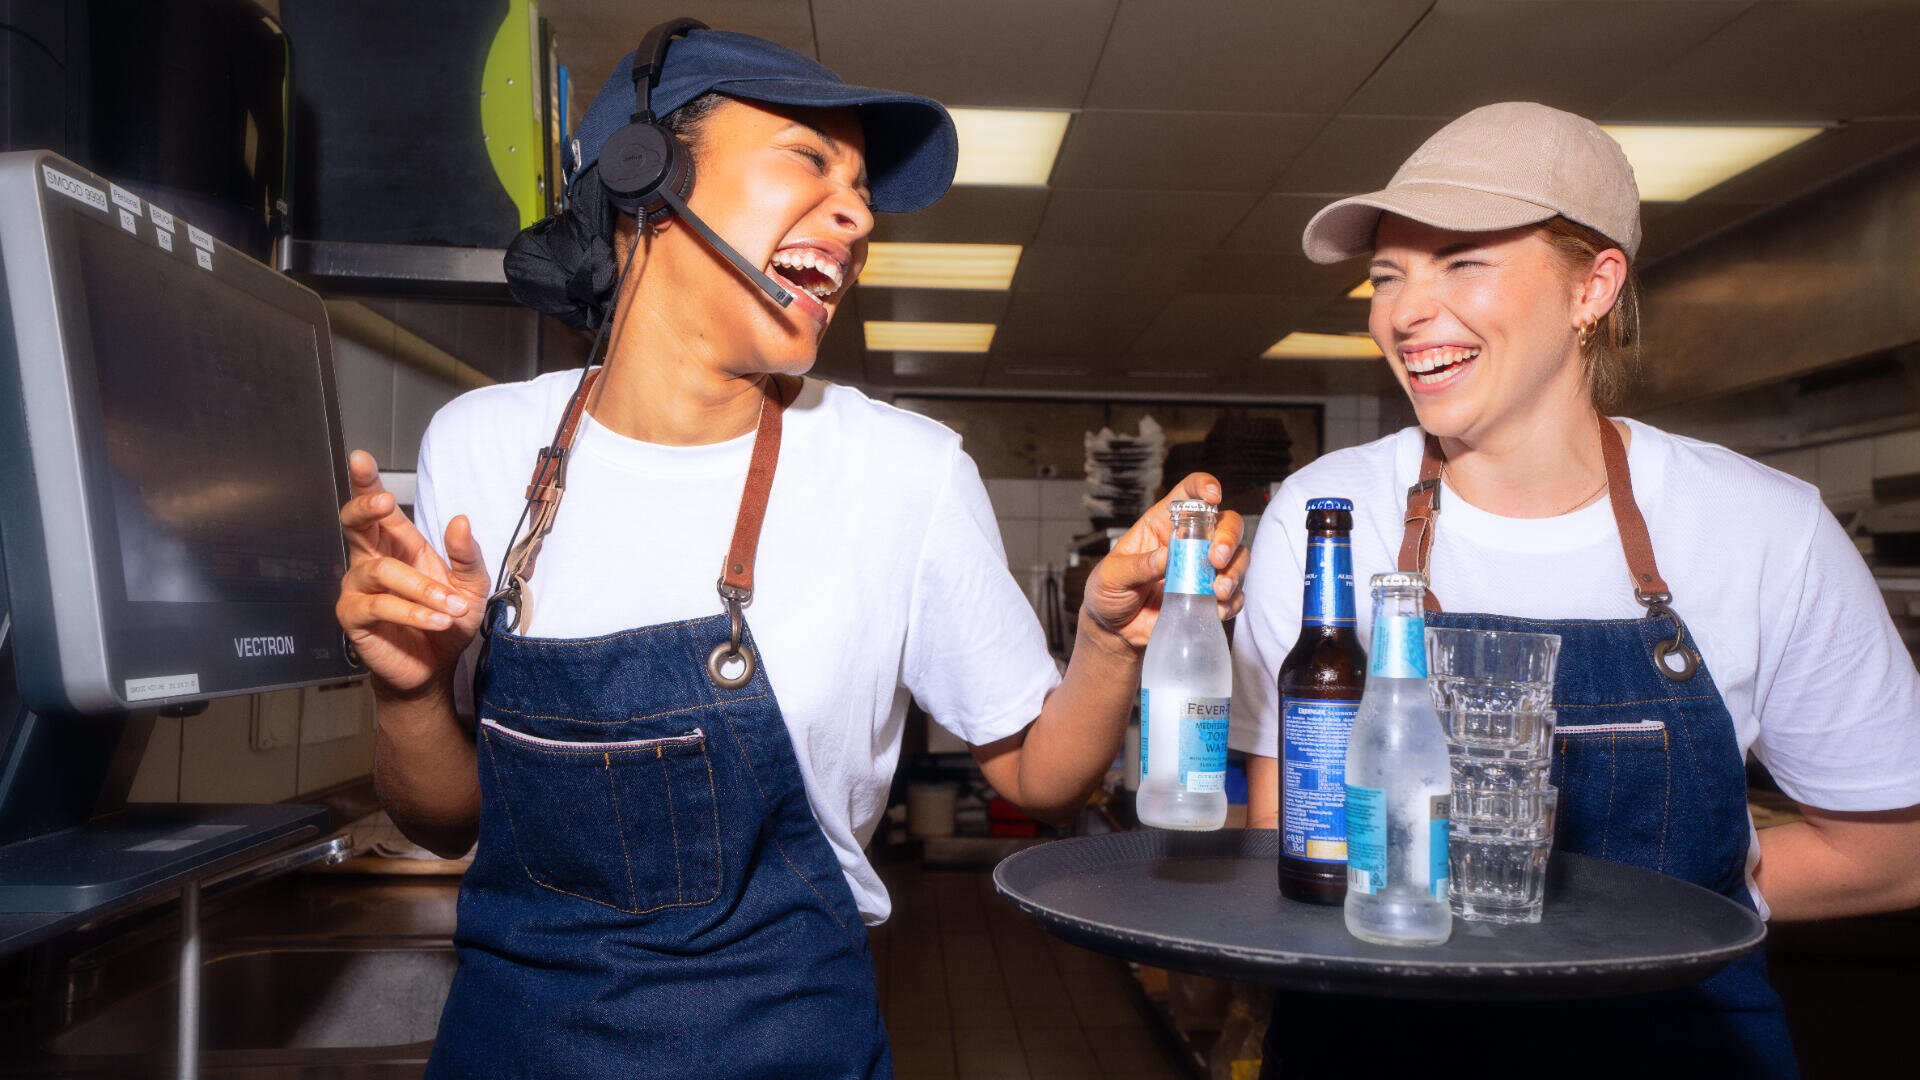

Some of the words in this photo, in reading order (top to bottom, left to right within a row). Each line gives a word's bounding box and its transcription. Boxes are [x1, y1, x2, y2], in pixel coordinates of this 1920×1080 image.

[46, 171, 83, 197] SMOOD
[84, 188, 106, 207] 9999
[233, 635, 296, 658] VECTRON
